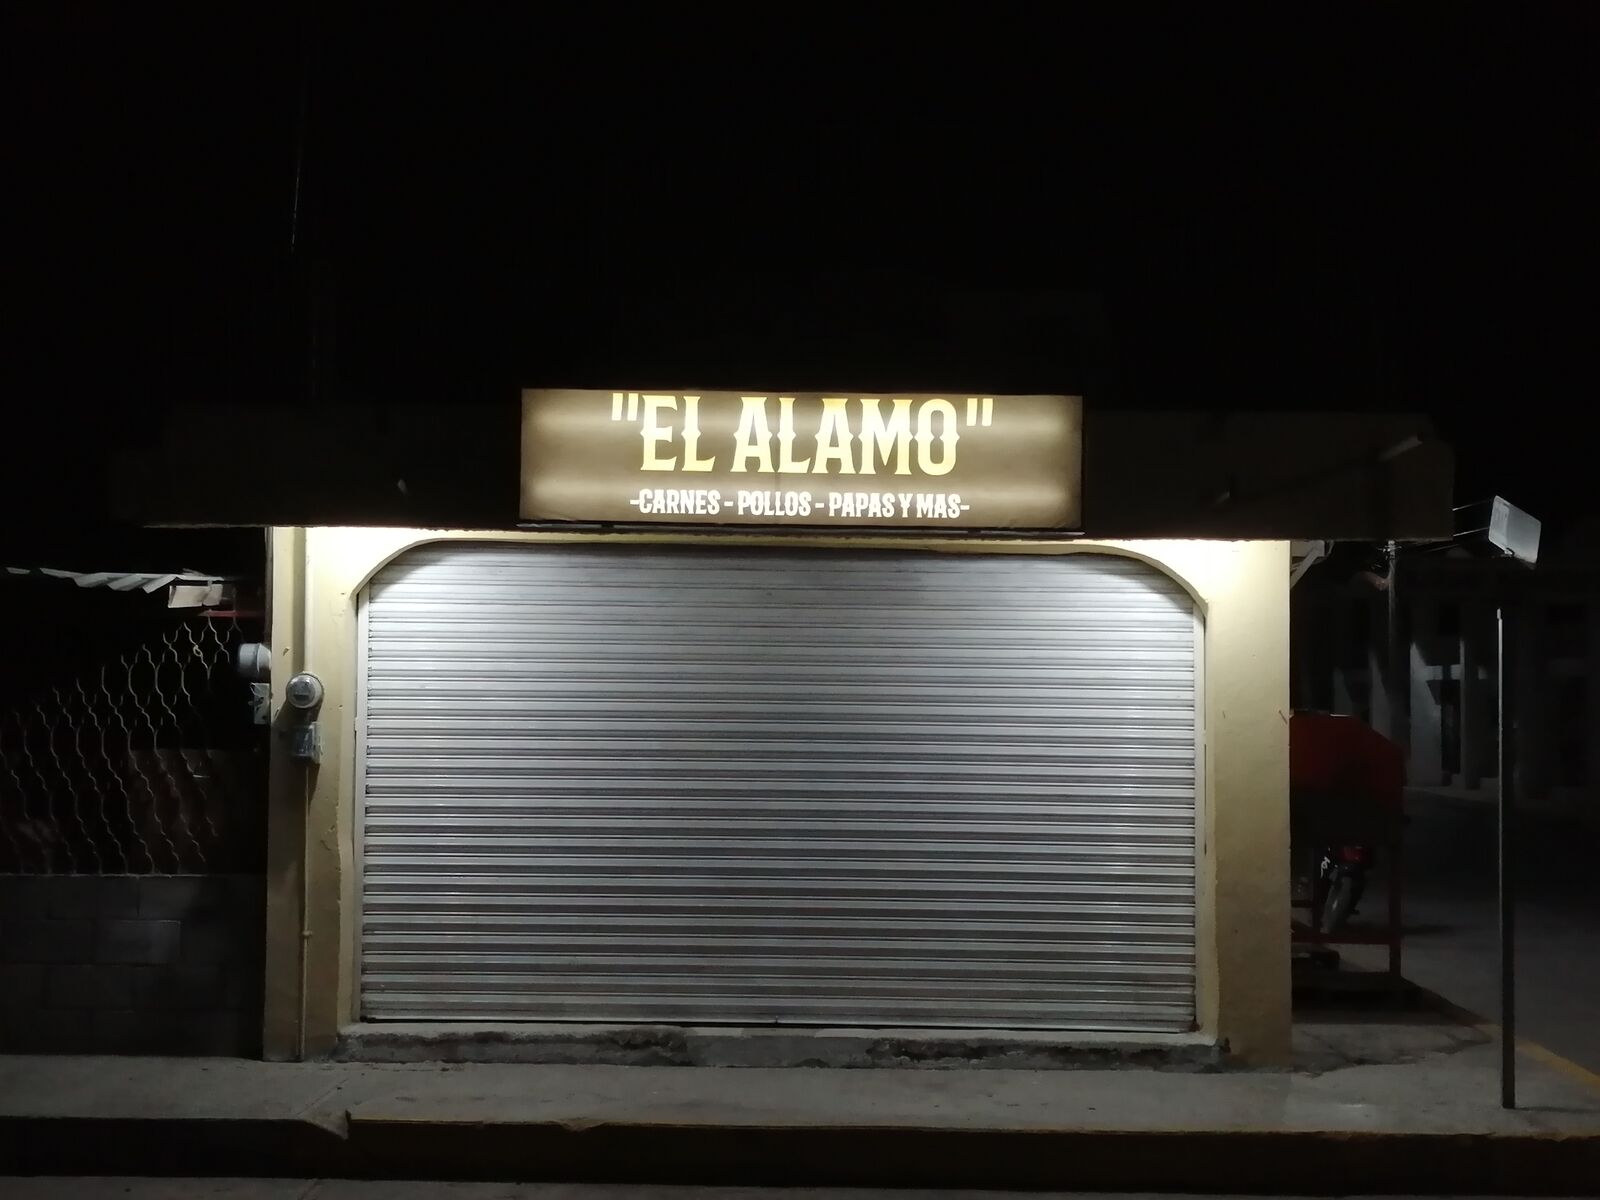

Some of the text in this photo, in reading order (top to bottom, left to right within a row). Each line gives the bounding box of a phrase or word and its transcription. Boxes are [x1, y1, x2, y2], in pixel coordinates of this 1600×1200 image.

[611, 392, 994, 476] "EL ALAMO"
[737, 490, 812, 517] POLLOS
[828, 492, 896, 518] PAPAS
[897, 493, 914, 518] Y
